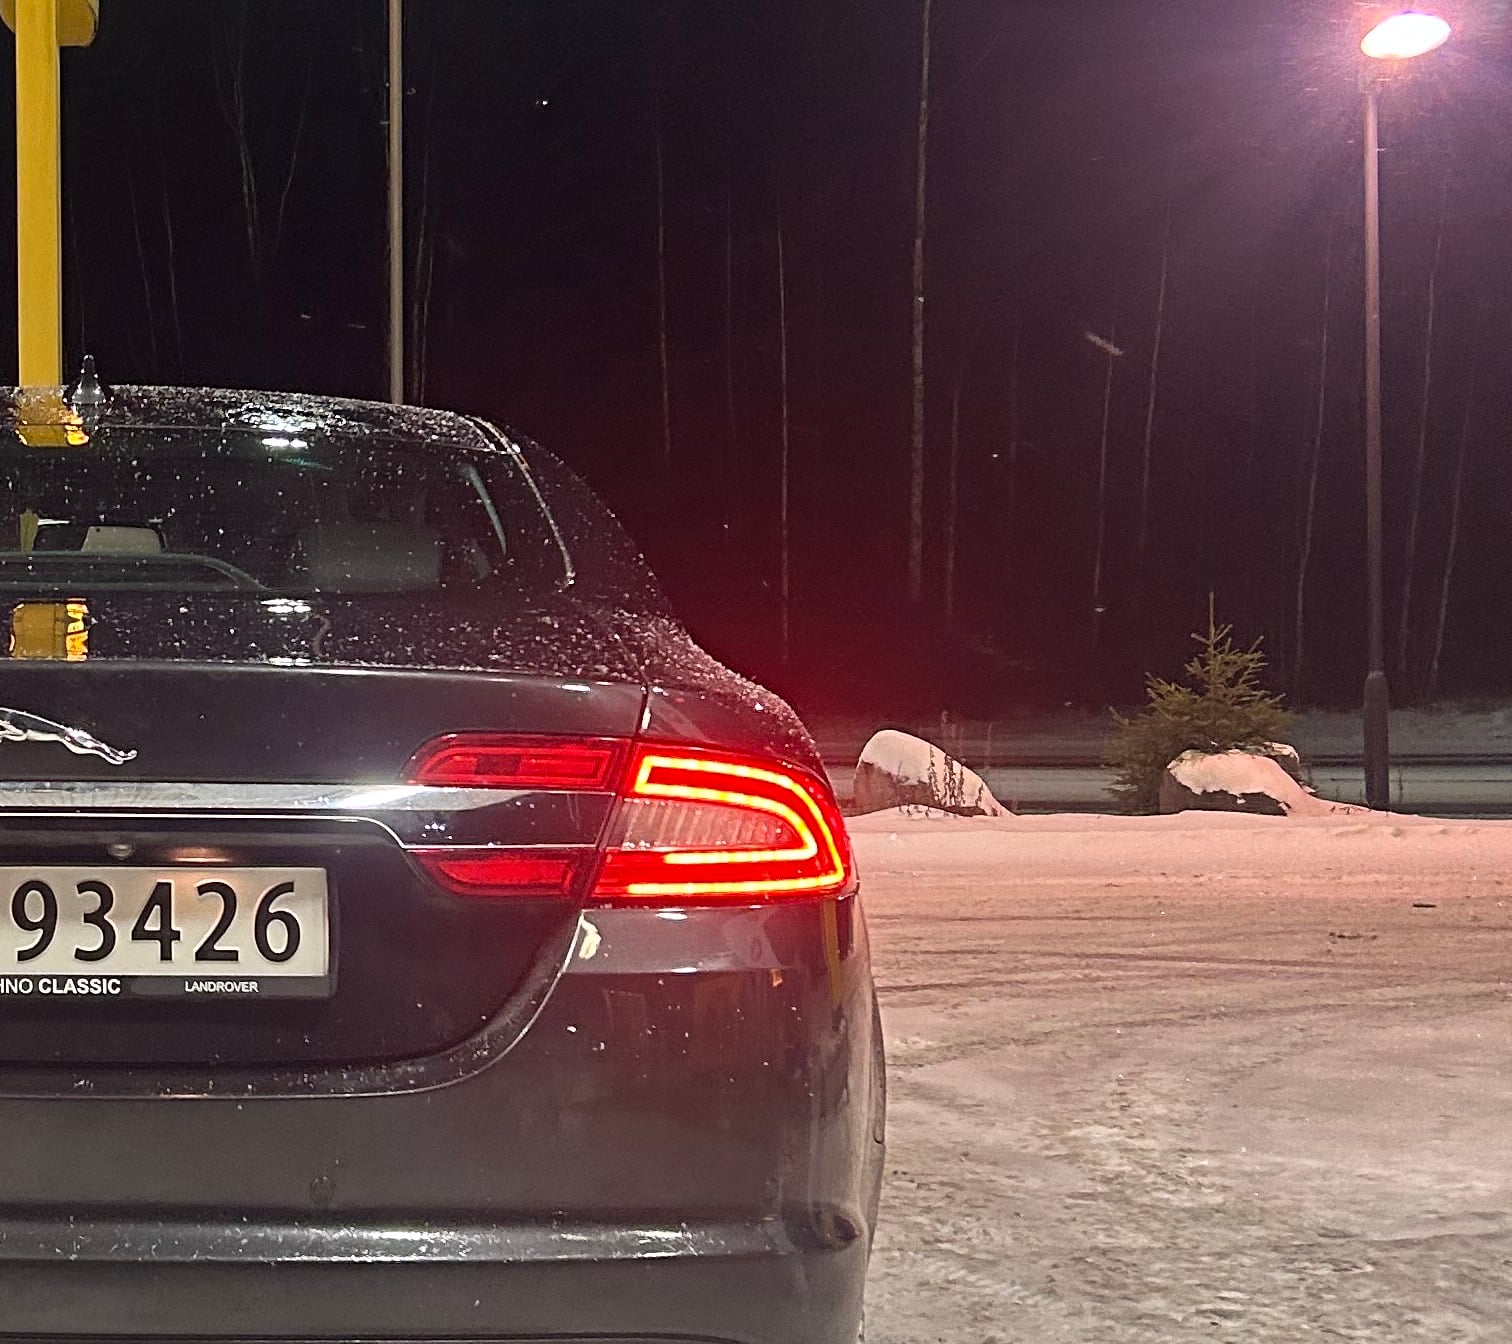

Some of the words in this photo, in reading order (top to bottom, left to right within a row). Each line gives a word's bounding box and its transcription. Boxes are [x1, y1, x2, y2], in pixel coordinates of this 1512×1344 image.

[10, 879, 302, 962] 93426
[38, 978, 122, 995] CLASSIC
[184, 981, 259, 993] LANDROVER
